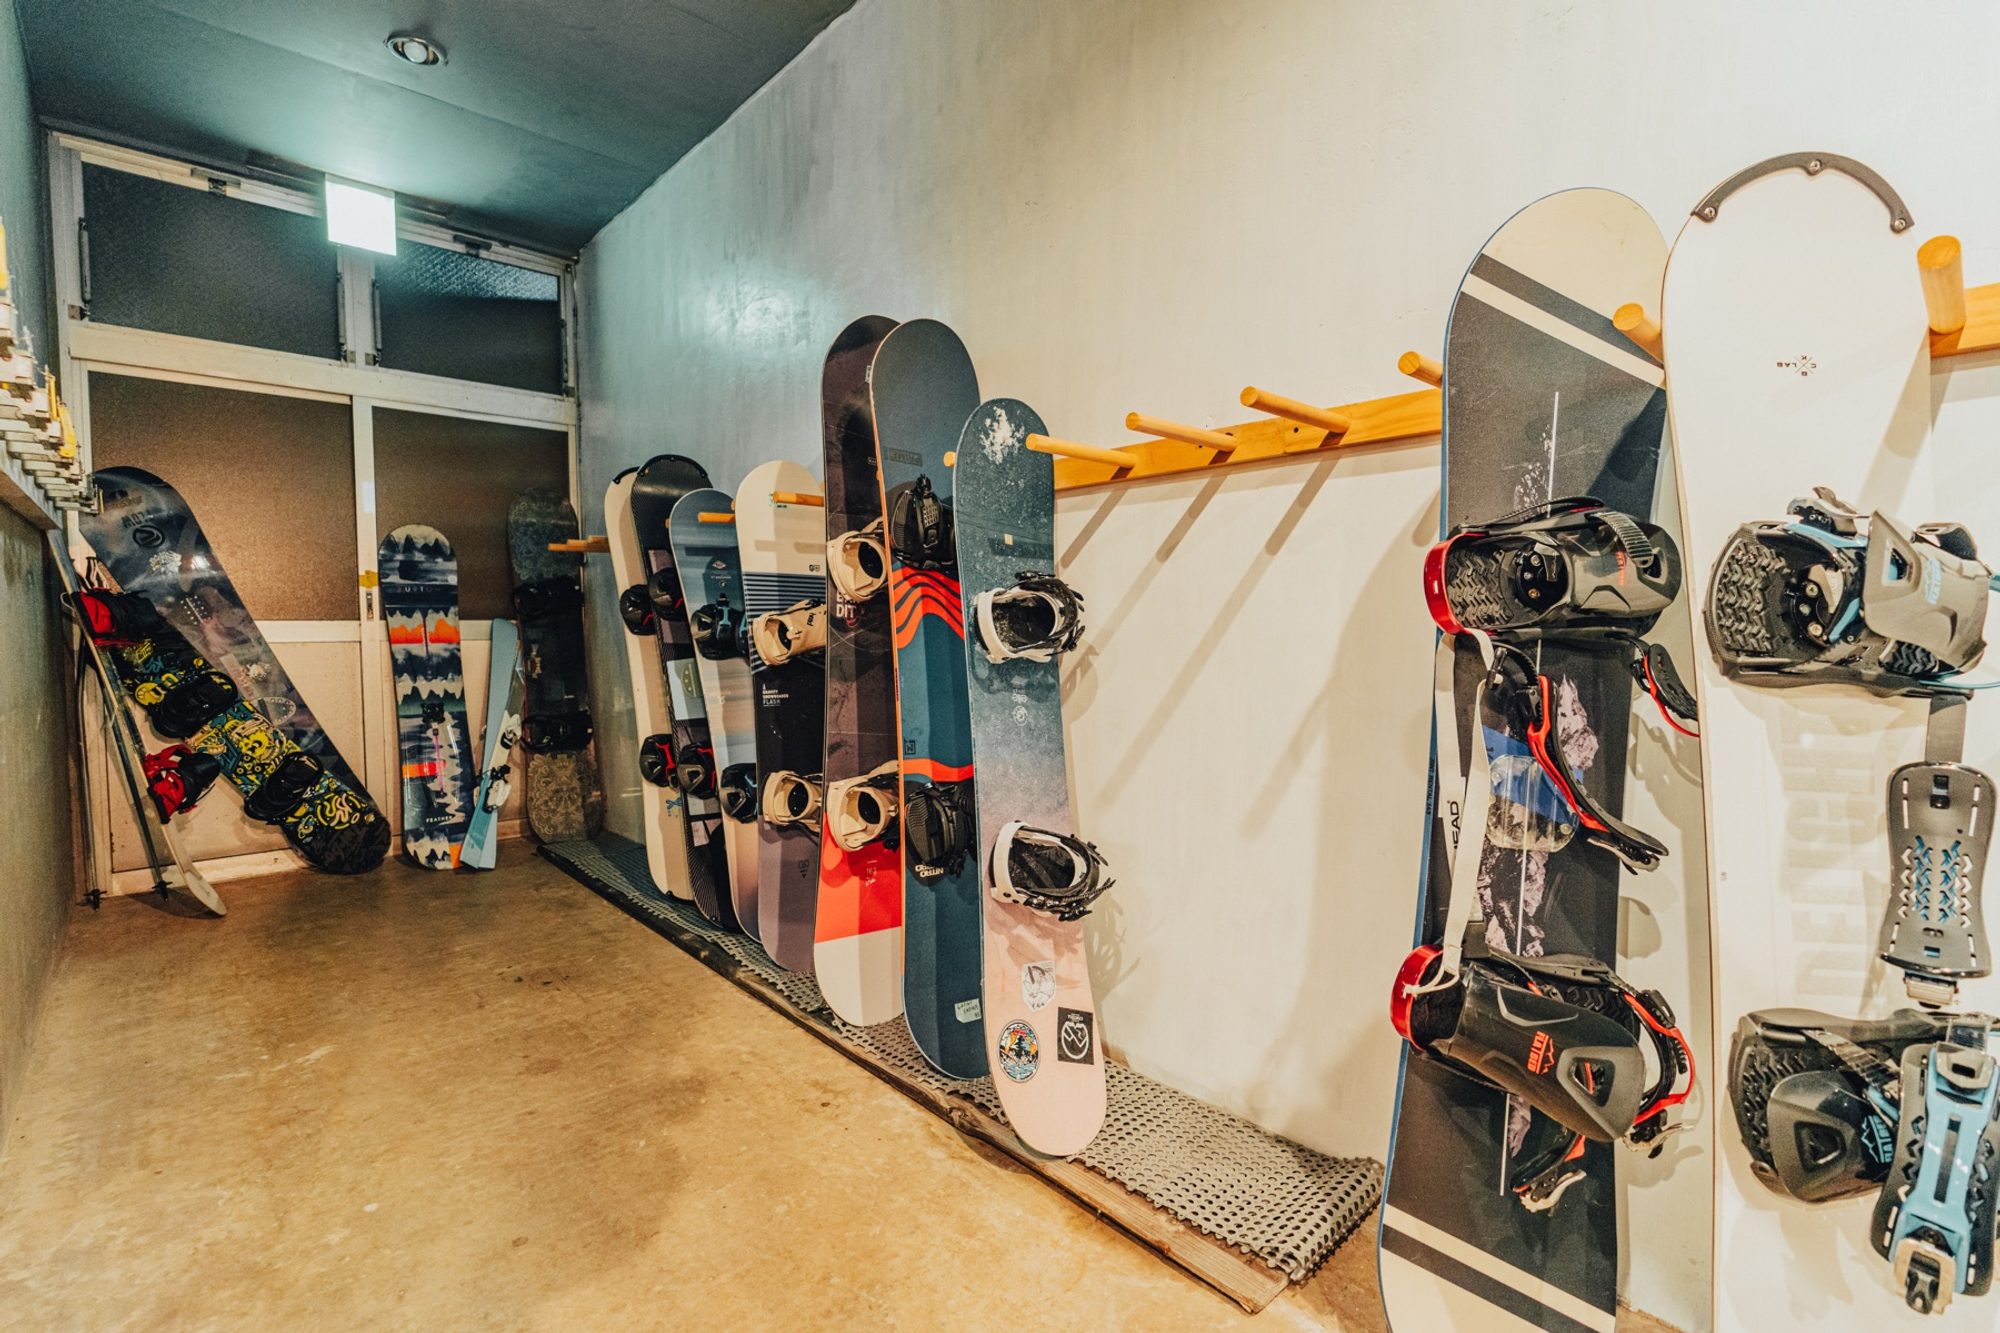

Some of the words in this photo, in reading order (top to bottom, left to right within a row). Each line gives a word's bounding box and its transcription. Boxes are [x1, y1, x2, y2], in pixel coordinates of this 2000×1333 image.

[889, 449, 921, 466] PRIME
[426, 815, 452, 823] FEATHER
[1450, 801, 1460, 849] EAD
[1780, 702, 1882, 995] DELIGHT
[920, 866, 944, 877] NITRO
[1527, 1031, 1545, 1074] FLATBED
